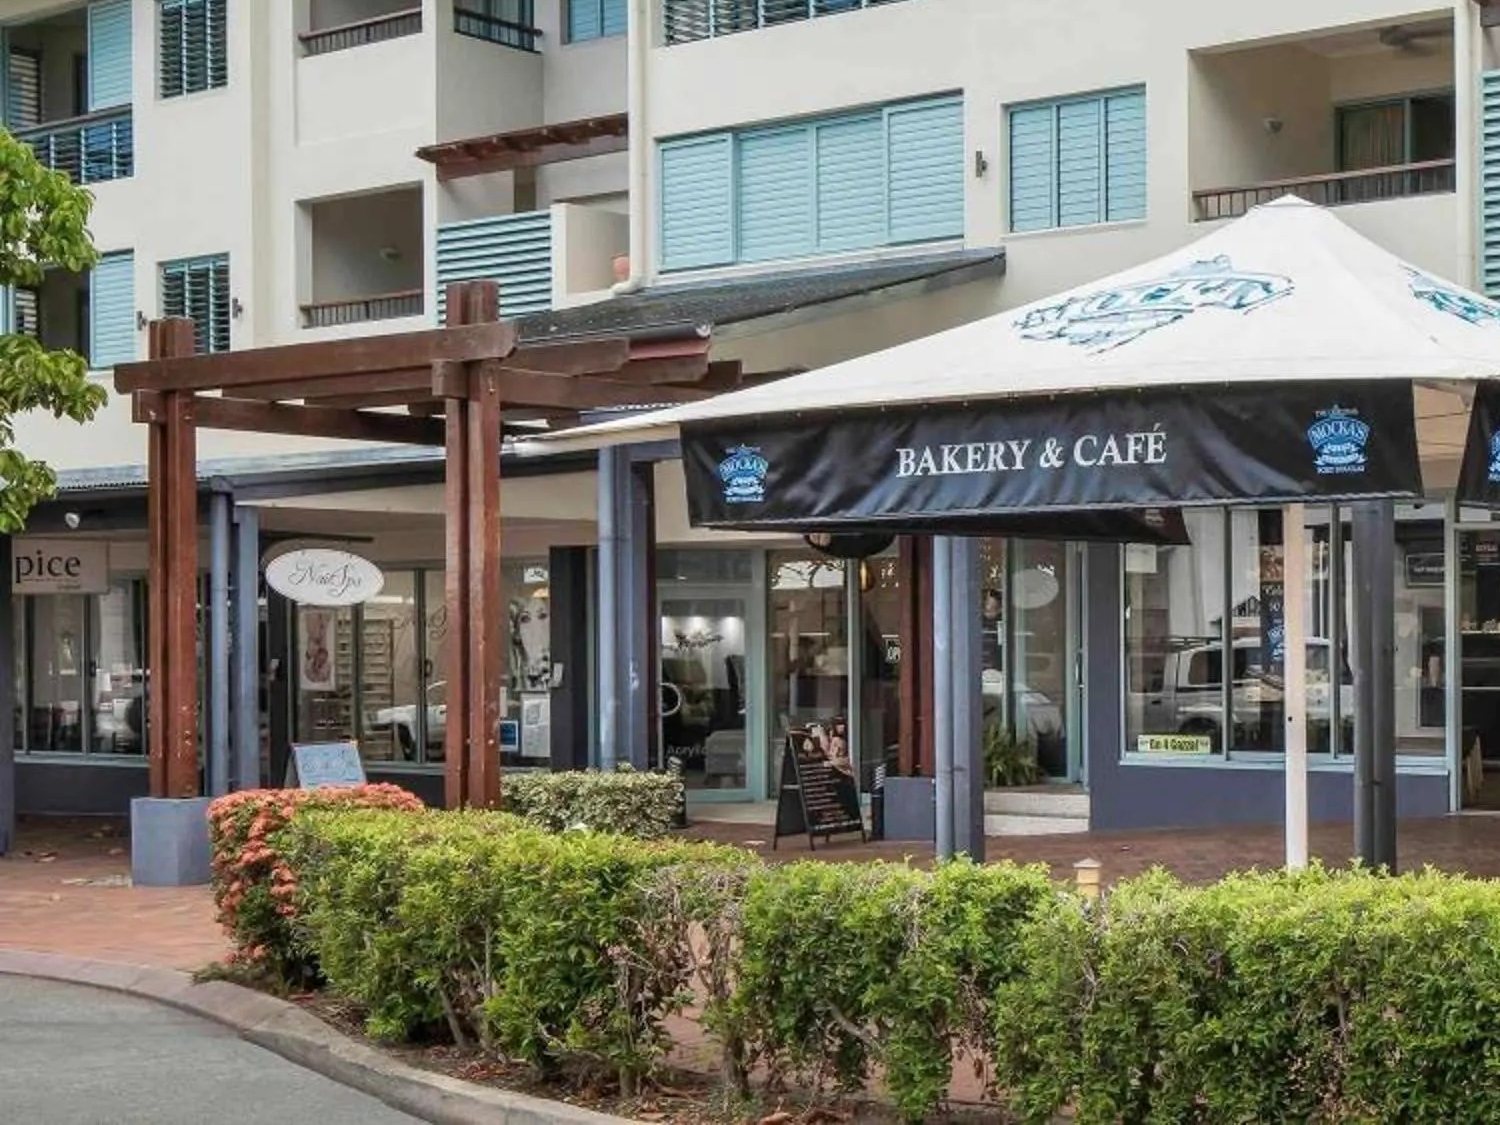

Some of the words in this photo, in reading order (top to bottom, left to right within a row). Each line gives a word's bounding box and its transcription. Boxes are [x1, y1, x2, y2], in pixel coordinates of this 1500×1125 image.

[896, 439, 1031, 477] BAKERY
[1039, 437, 1065, 468] &
[1073, 423, 1167, 466] CAFÉ
[16, 549, 81, 584] pice
